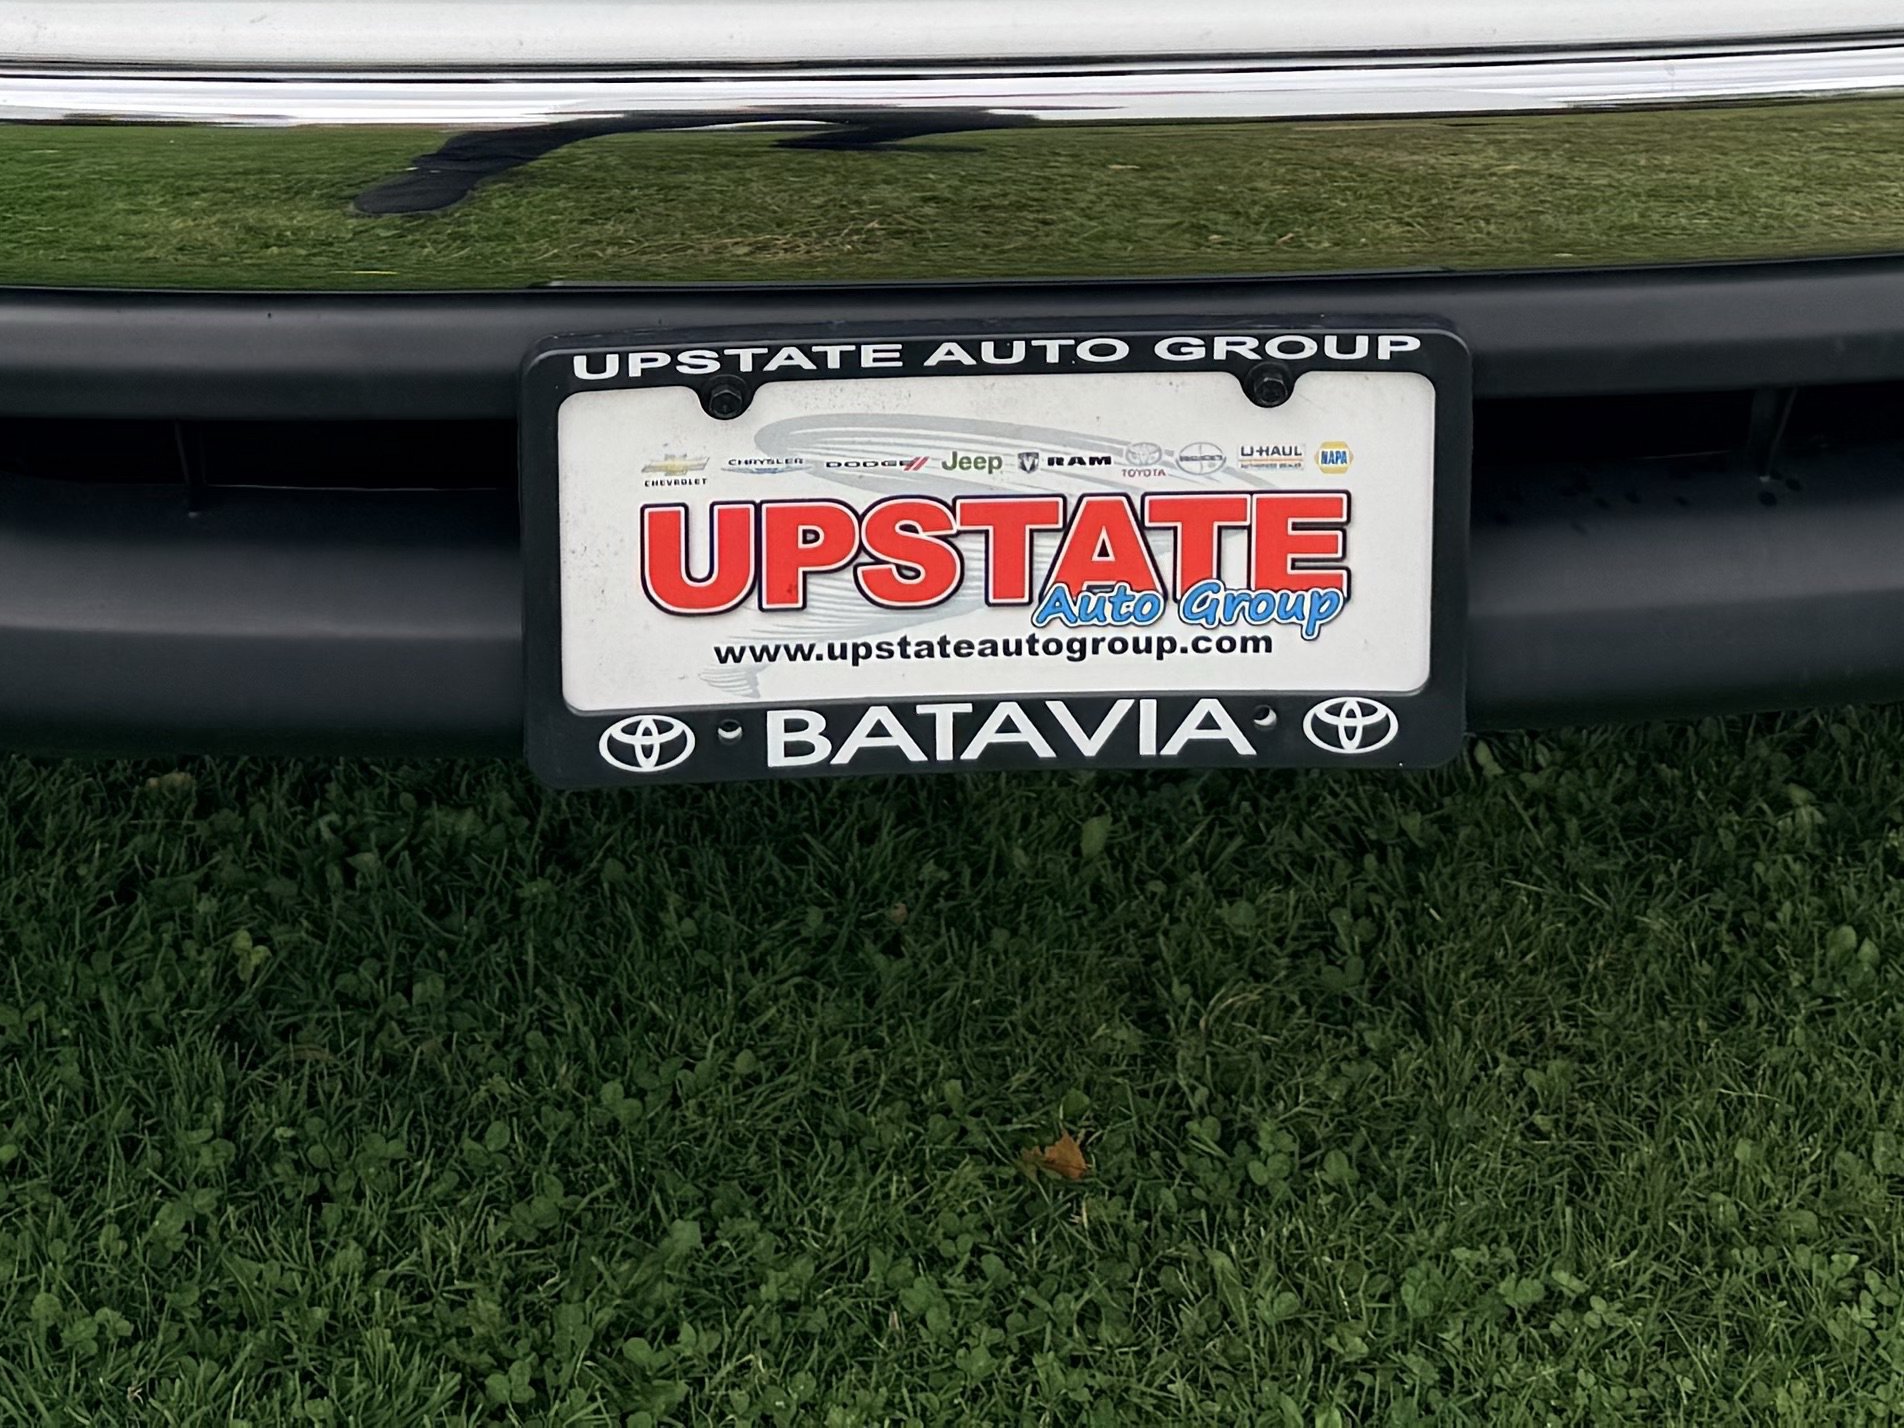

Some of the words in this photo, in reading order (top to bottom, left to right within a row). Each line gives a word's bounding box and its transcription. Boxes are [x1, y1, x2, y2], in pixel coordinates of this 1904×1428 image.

[573, 343, 904, 380] UPSTATE
[923, 336, 1130, 367] AUTO
[1154, 335, 1422, 361] GROUP
[1240, 445, 1303, 457] U-HAUL
[1320, 450, 1348, 465] NAPA
[728, 457, 804, 467] CHRYSLER
[825, 459, 913, 469] DODGE
[941, 451, 1003, 475] Jeep
[1046, 455, 1112, 466] RAM
[1121, 468, 1167, 478] TOYOTA
[644, 478, 708, 488] CHEVROLET
[642, 490, 1352, 615] UPSTATE
[1031, 581, 1166, 628] Auto
[1178, 578, 1346, 640] Group
[713, 633, 1274, 666] www.upstateautogroup.com
[766, 698, 1258, 768] BATAVIA
